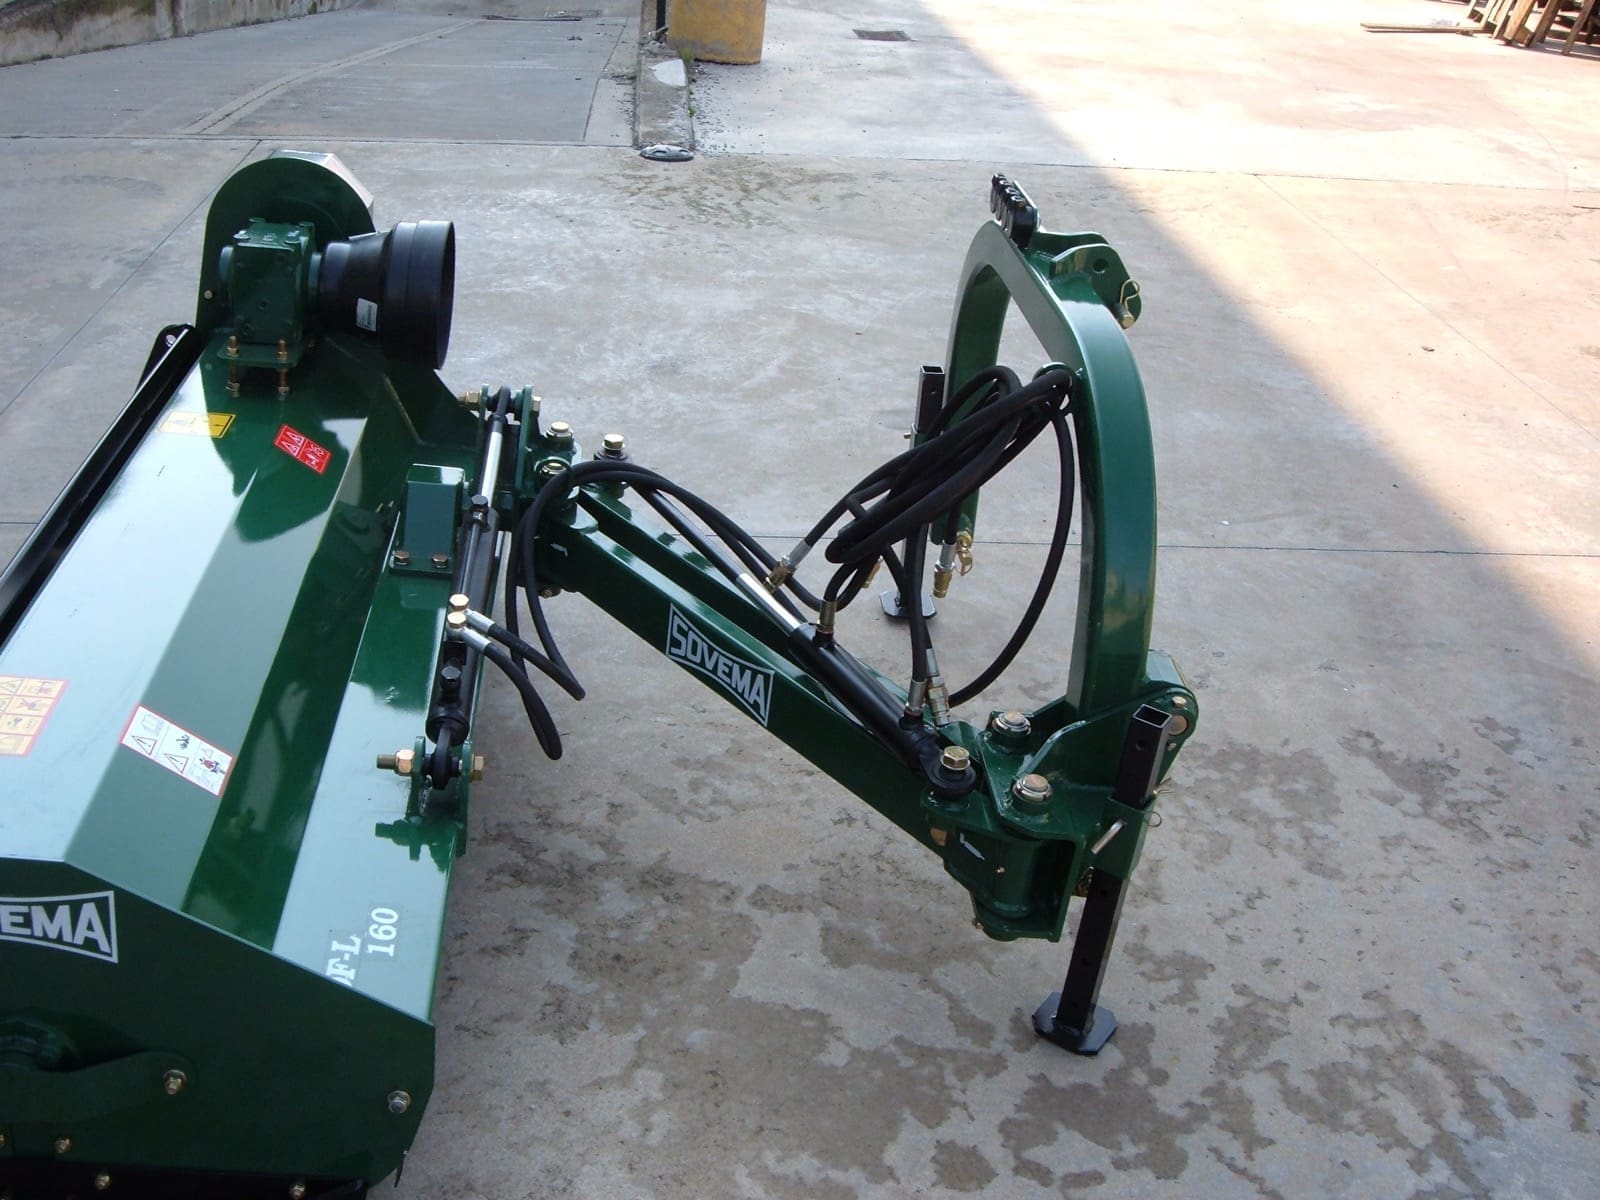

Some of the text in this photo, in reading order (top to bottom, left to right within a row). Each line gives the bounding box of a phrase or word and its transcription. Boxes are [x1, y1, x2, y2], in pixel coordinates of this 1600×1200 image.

[670, 615, 767, 719] SOVEMA
[0, 902, 111, 953] EMA
[367, 907, 399, 957] 160
